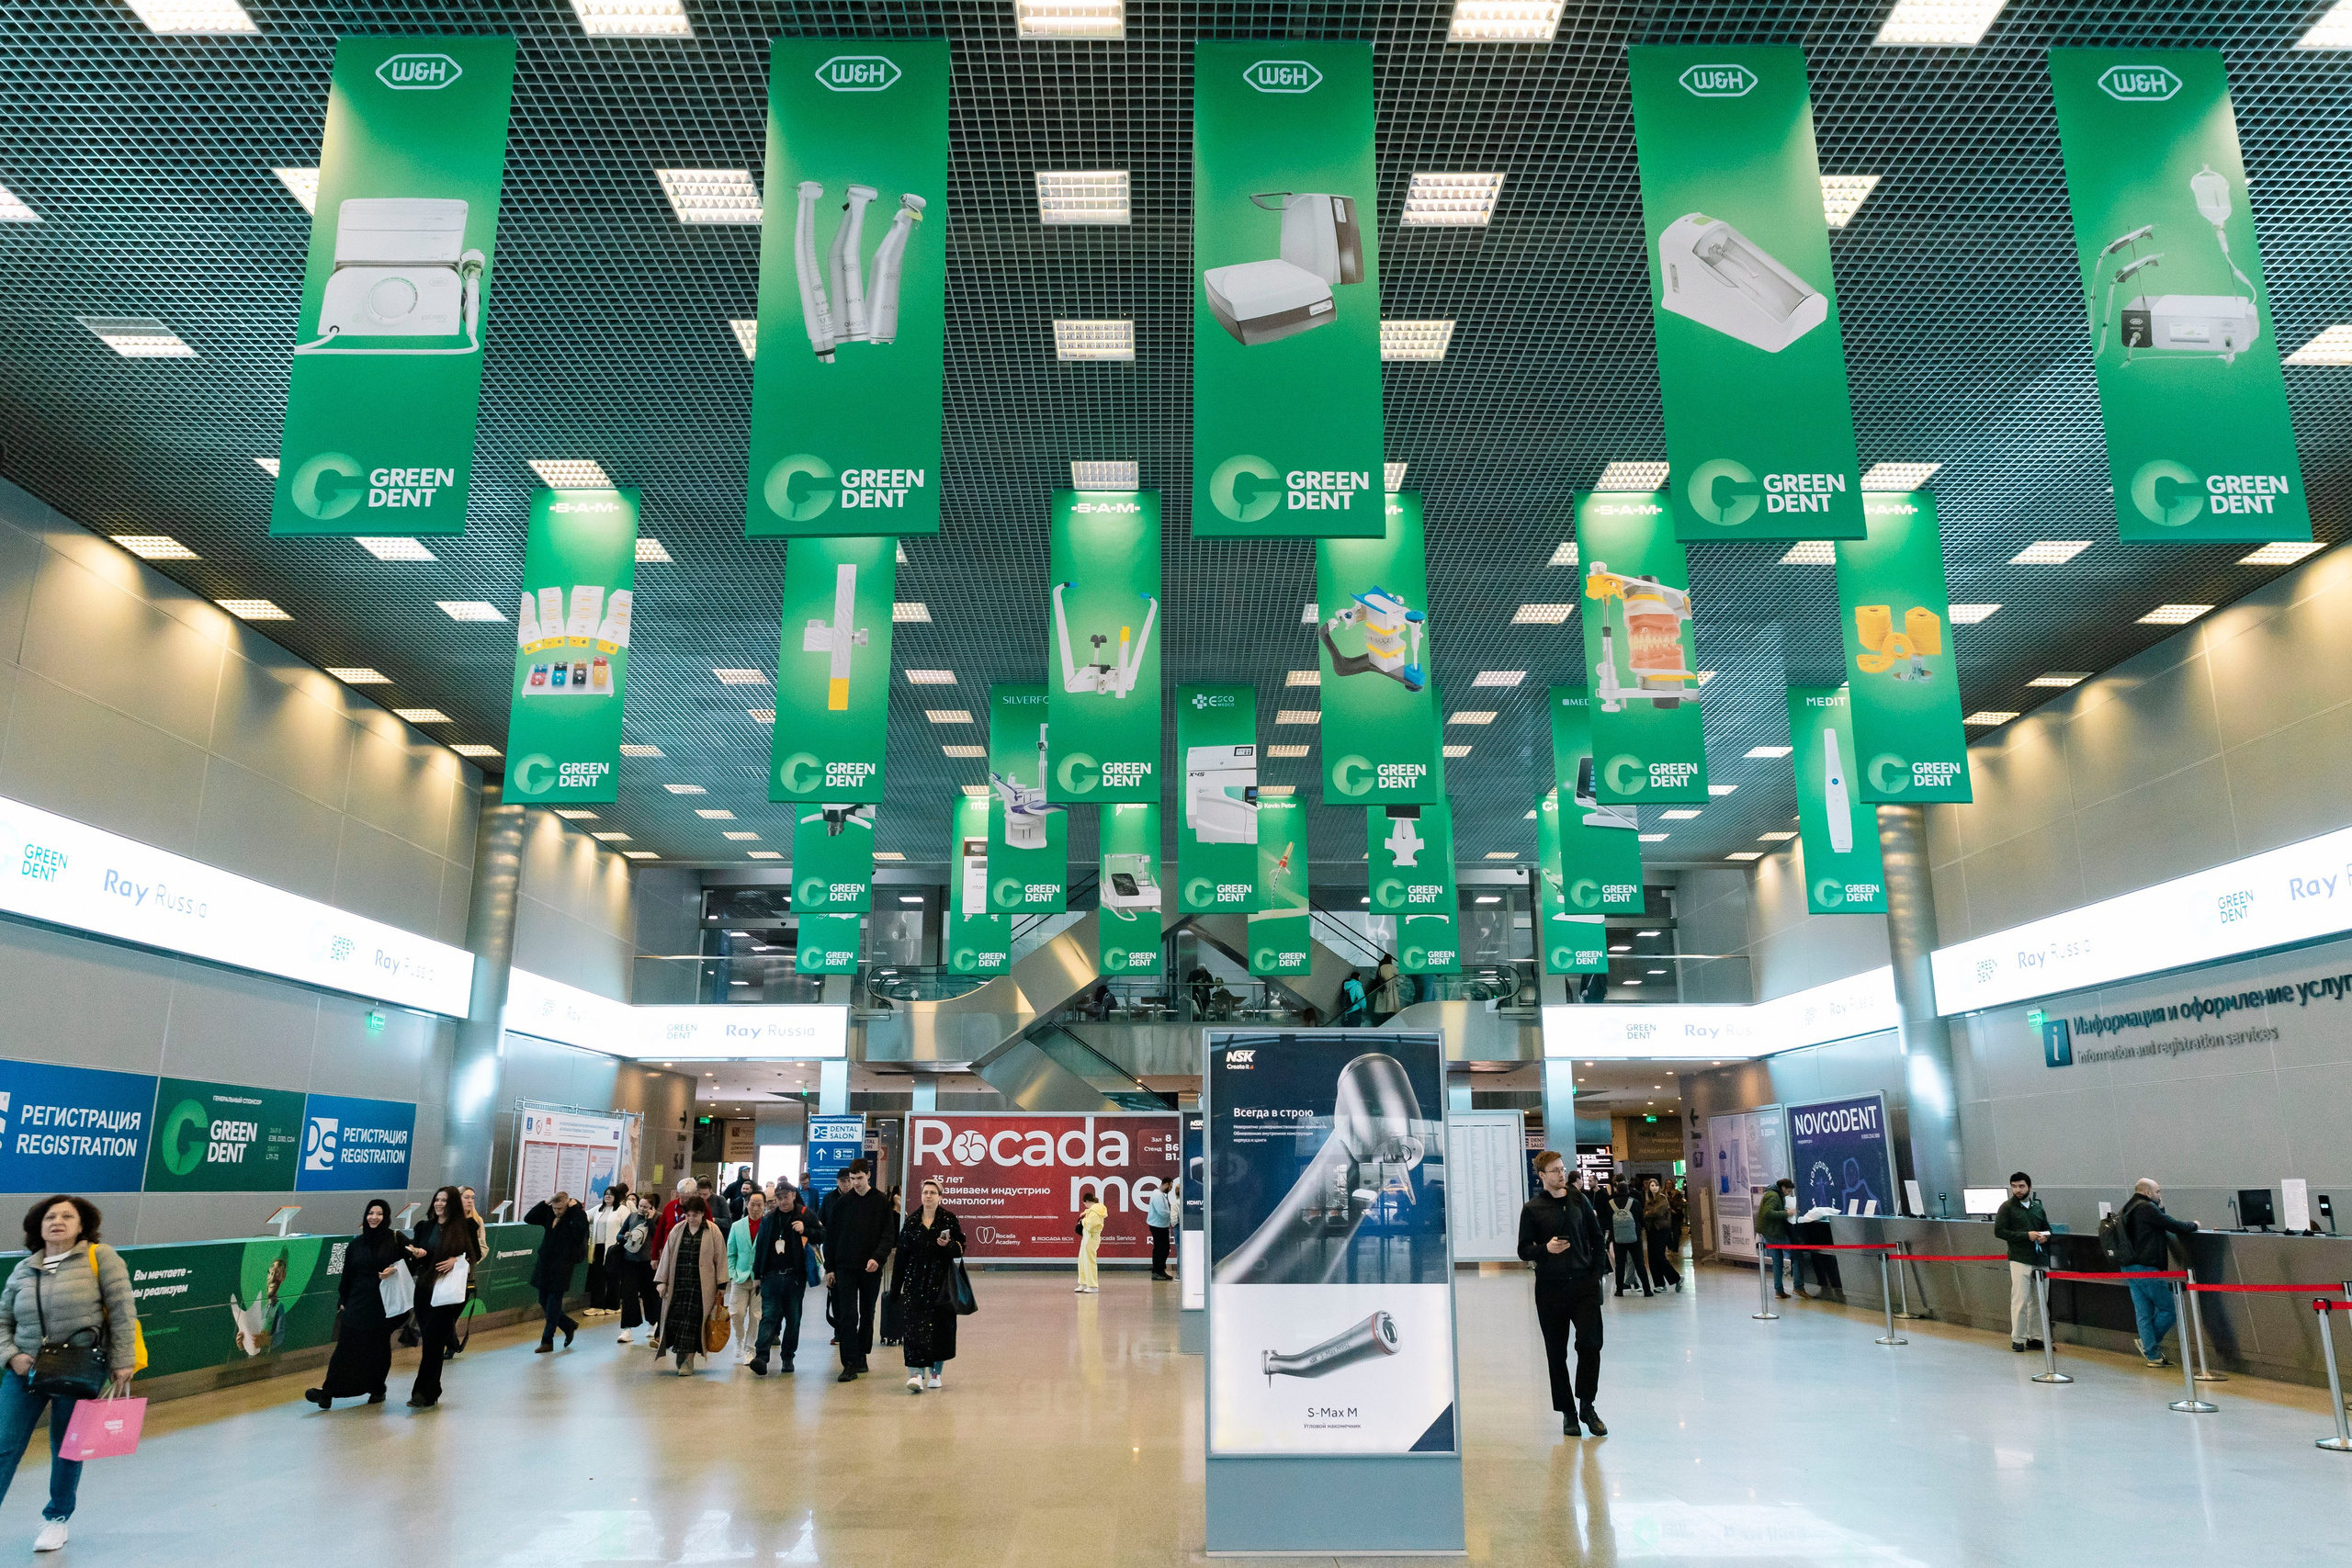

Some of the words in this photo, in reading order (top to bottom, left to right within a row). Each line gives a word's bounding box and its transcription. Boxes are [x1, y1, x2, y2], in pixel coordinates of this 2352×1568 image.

[392, 62, 447, 81] W&H
[831, 64, 885, 83] W&H
[1259, 67, 1306, 85] W&H
[1693, 72, 1743, 89] W&H
[2113, 73, 2167, 93] W&H
[370, 468, 454, 487] GREEN
[842, 469, 924, 488] GREEN
[1286, 471, 1369, 490] GREEN
[1764, 474, 1845, 492] GREEN
[2207, 476, 2289, 494] GREEN
[368, 489, 436, 508] DENT
[842, 490, 908, 508] DENT
[1288, 491, 1353, 510] DENT
[1767, 494, 1831, 513] DENT
[2211, 495, 2275, 513] DENT
[1806, 697, 1846, 706] MEDIT
[560, 762, 609, 774] GREEN
[826, 762, 876, 774] GREEN
[1102, 762, 1151, 774] GREEN
[1377, 764, 1426, 775] GREEN
[1649, 763, 1698, 774] GREEN
[1912, 762, 1961, 773] GREEN
[560, 775, 599, 786] DENT
[826, 775, 865, 786] DENT
[1103, 775, 1142, 786] DENT
[1379, 776, 1417, 788] DENT
[1651, 775, 1689, 787] DENT
[1914, 775, 1951, 786] DENT
[25, 843, 69, 869] GREEN
[21, 861, 57, 883] DENT
[104, 868, 149, 907] Ray
[830, 884, 865, 893] GREEN
[1025, 885, 1059, 893] GREEN
[1217, 885, 1252, 893] GREEN
[1408, 886, 1442, 894] GREEN
[1602, 885, 1636, 893] GREEN
[1846, 885, 1880, 893] GREEN
[2290, 874, 2337, 901] Ray
[830, 893, 857, 902] DENT
[1025, 894, 1053, 902] DENT
[1217, 894, 1245, 902] DENT
[1408, 895, 1436, 903] DENT
[1603, 894, 1630, 902] DENT
[1847, 894, 1873, 902] DENT
[2218, 889, 2254, 909] GREEN
[2220, 905, 2247, 924] DENT
[375, 949, 400, 976] Ray
[2018, 951, 2046, 969] Ray
[2074, 1007, 2165, 1037] Информация
[2168, 1005, 2178, 1021] и
[2179, 985, 2294, 1021] оформление
[726, 1024, 762, 1039] Ray
[769, 1024, 815, 1036] Russia
[1685, 1024, 1720, 1039] Ray
[2135, 1042, 2156, 1056] and
[2157, 1032, 2224, 1057] registration
[2225, 1025, 2278, 1045] services
[1226, 1050, 1256, 1062] NSK
[21, 1104, 141, 1133] РЕГИСТРАЦИЯ
[1233, 1108, 1269, 1119] Всегда
[1280, 1109, 1314, 1119] строю
[1794, 1105, 1877, 1136] NOVGODENT
[210, 1120, 258, 1142] GREEN
[343, 1127, 408, 1146] РЕГИСТРАЦИЯ
[16, 1134, 138, 1156] REGISTRATION
[207, 1143, 247, 1163] DENT
[341, 1148, 406, 1164] REGISTRATION
[835, 1150, 842, 1158] 3
[991, 1188, 1050, 1196] индустрию
[133, 1269, 147, 1281] Вы
[148, 1268, 187, 1279] мечтаете
[143, 1284, 188, 1300] реализуем
[1307, 1407, 1344, 1417] S-Max
[1347, 1407, 1358, 1417] M
